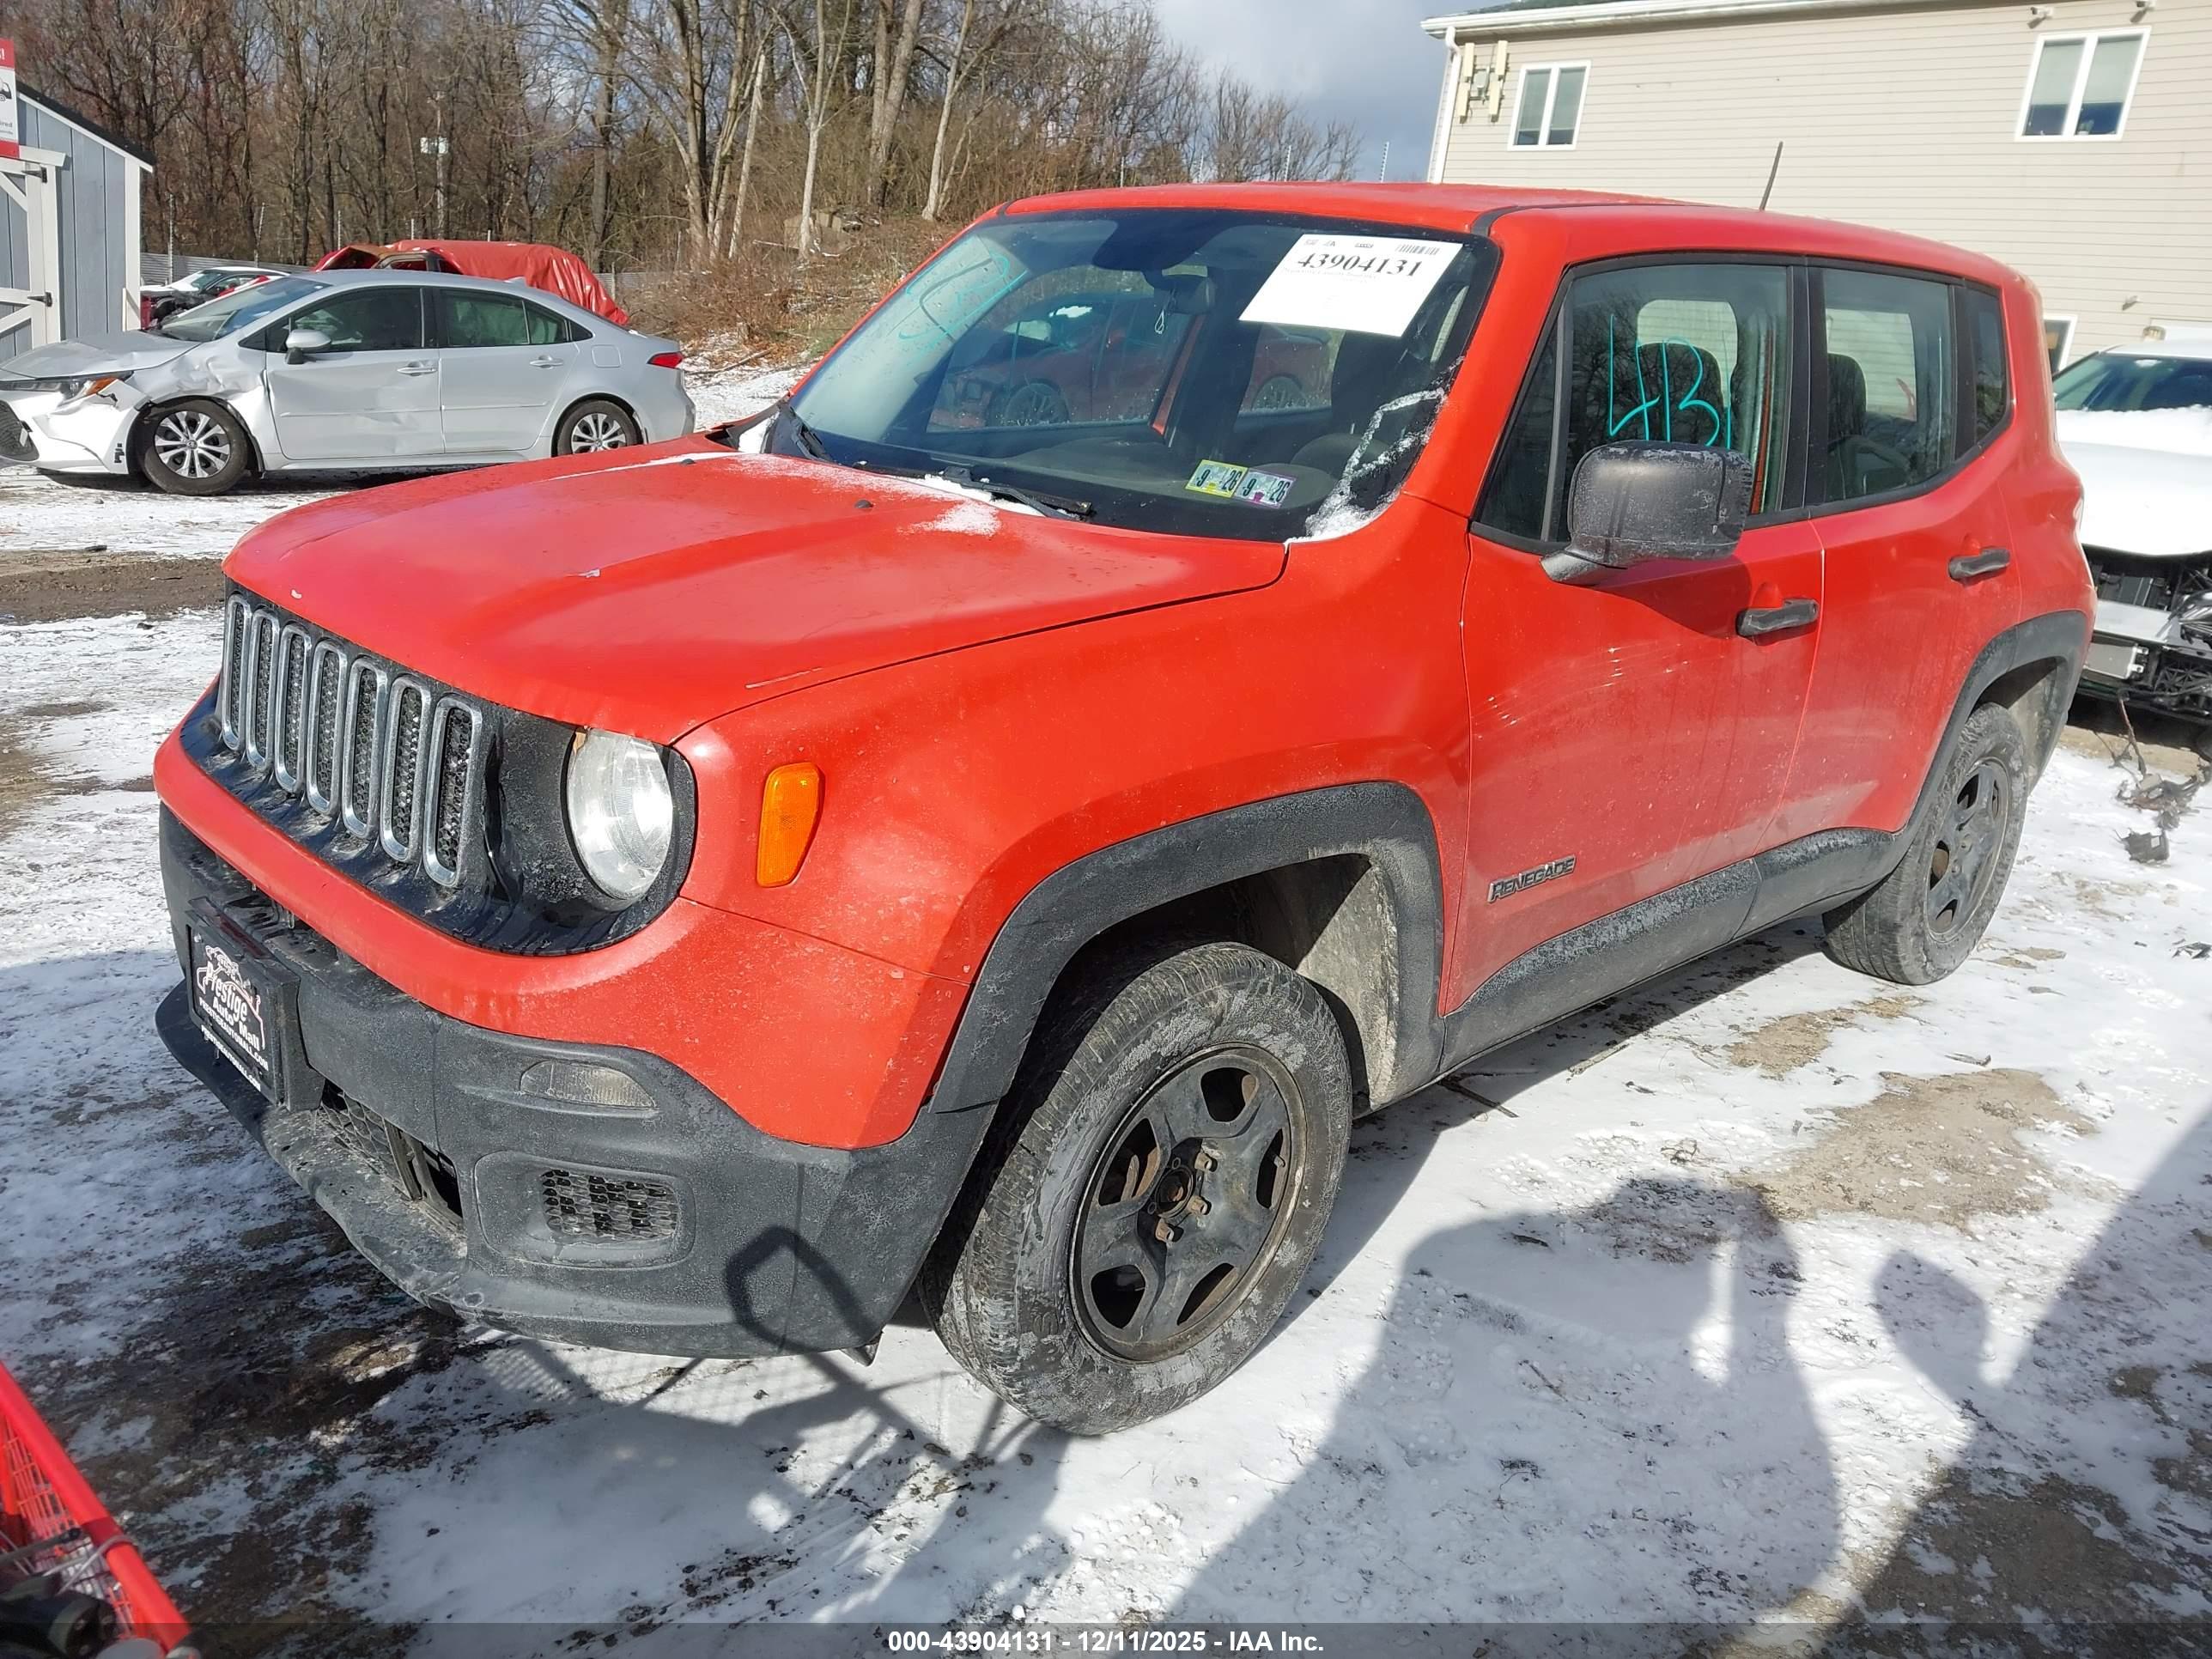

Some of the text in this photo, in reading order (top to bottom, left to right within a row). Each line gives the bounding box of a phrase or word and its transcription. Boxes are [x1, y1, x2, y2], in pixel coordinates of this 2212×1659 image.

[1297, 252, 1423, 276] 43904131
[1196, 469, 1243, 492] 9 26
[1243, 478, 1291, 503] 9 26
[1487, 854, 1577, 903] RENEGADE
[205, 960, 248, 1023] Prestige
[212, 996, 261, 1052] Auto Mall
